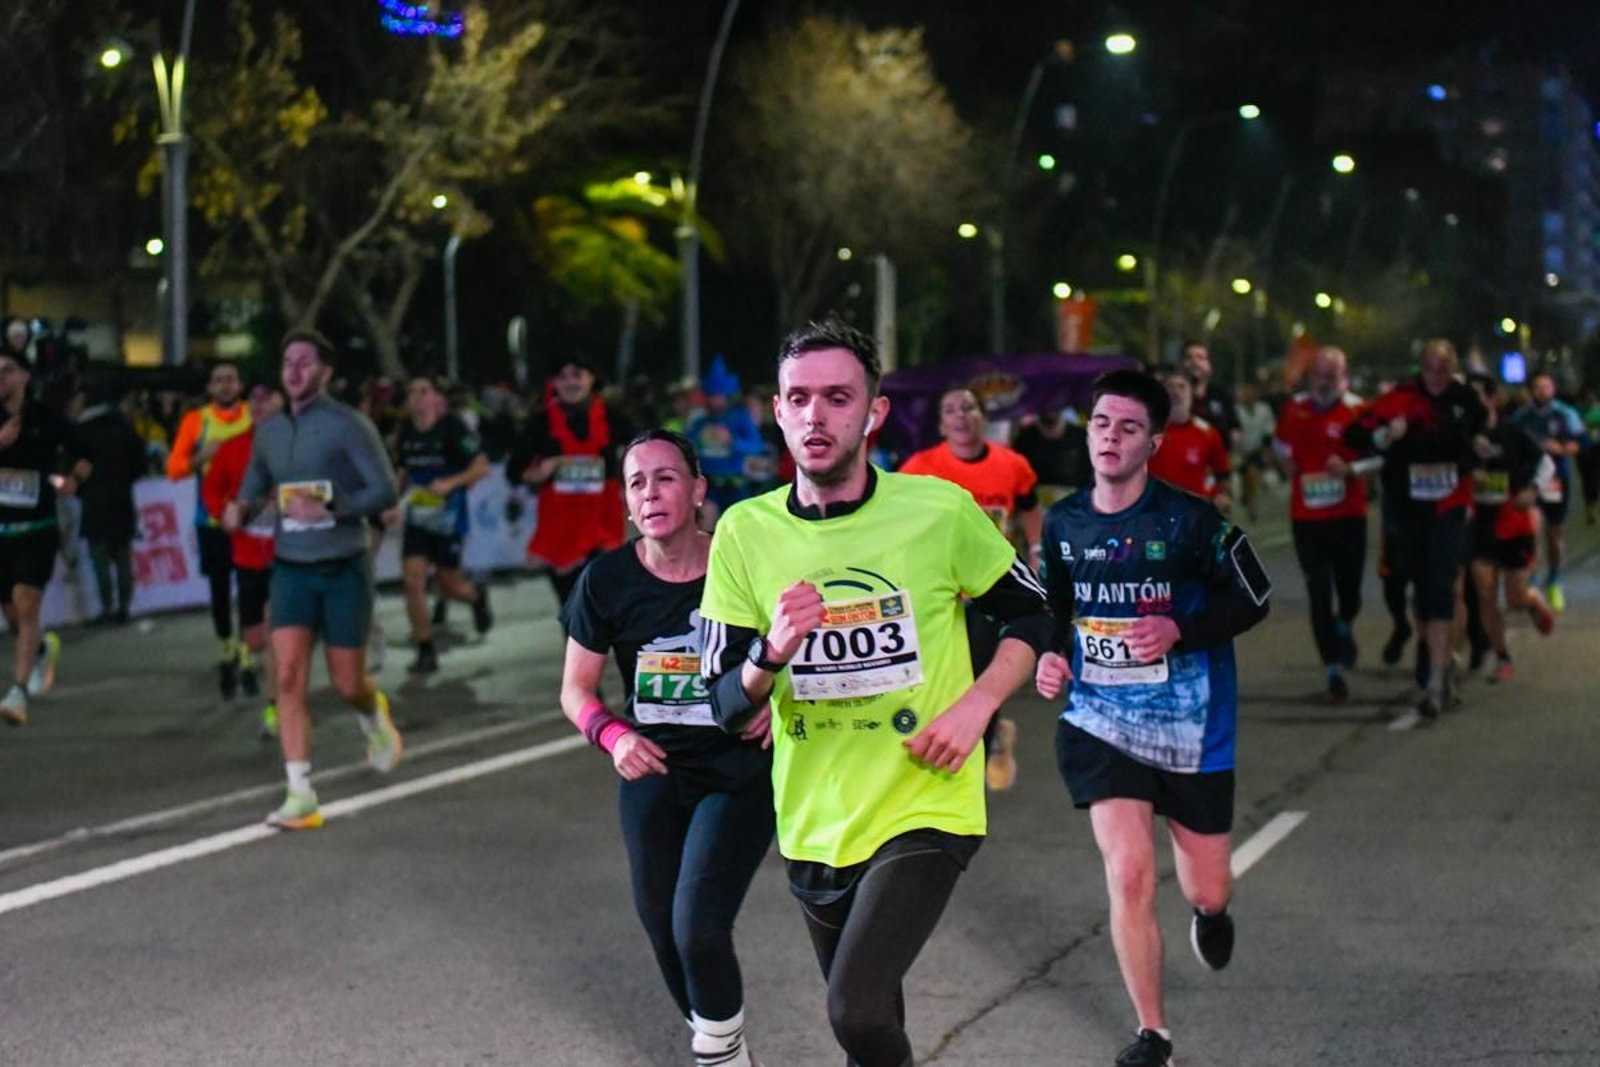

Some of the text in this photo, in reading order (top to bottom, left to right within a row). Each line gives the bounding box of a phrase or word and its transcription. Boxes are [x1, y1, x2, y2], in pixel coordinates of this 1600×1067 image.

[1098, 577, 1171, 603] ANTÓN
[803, 622, 905, 662] 7003
[1086, 635, 1131, 660] 661
